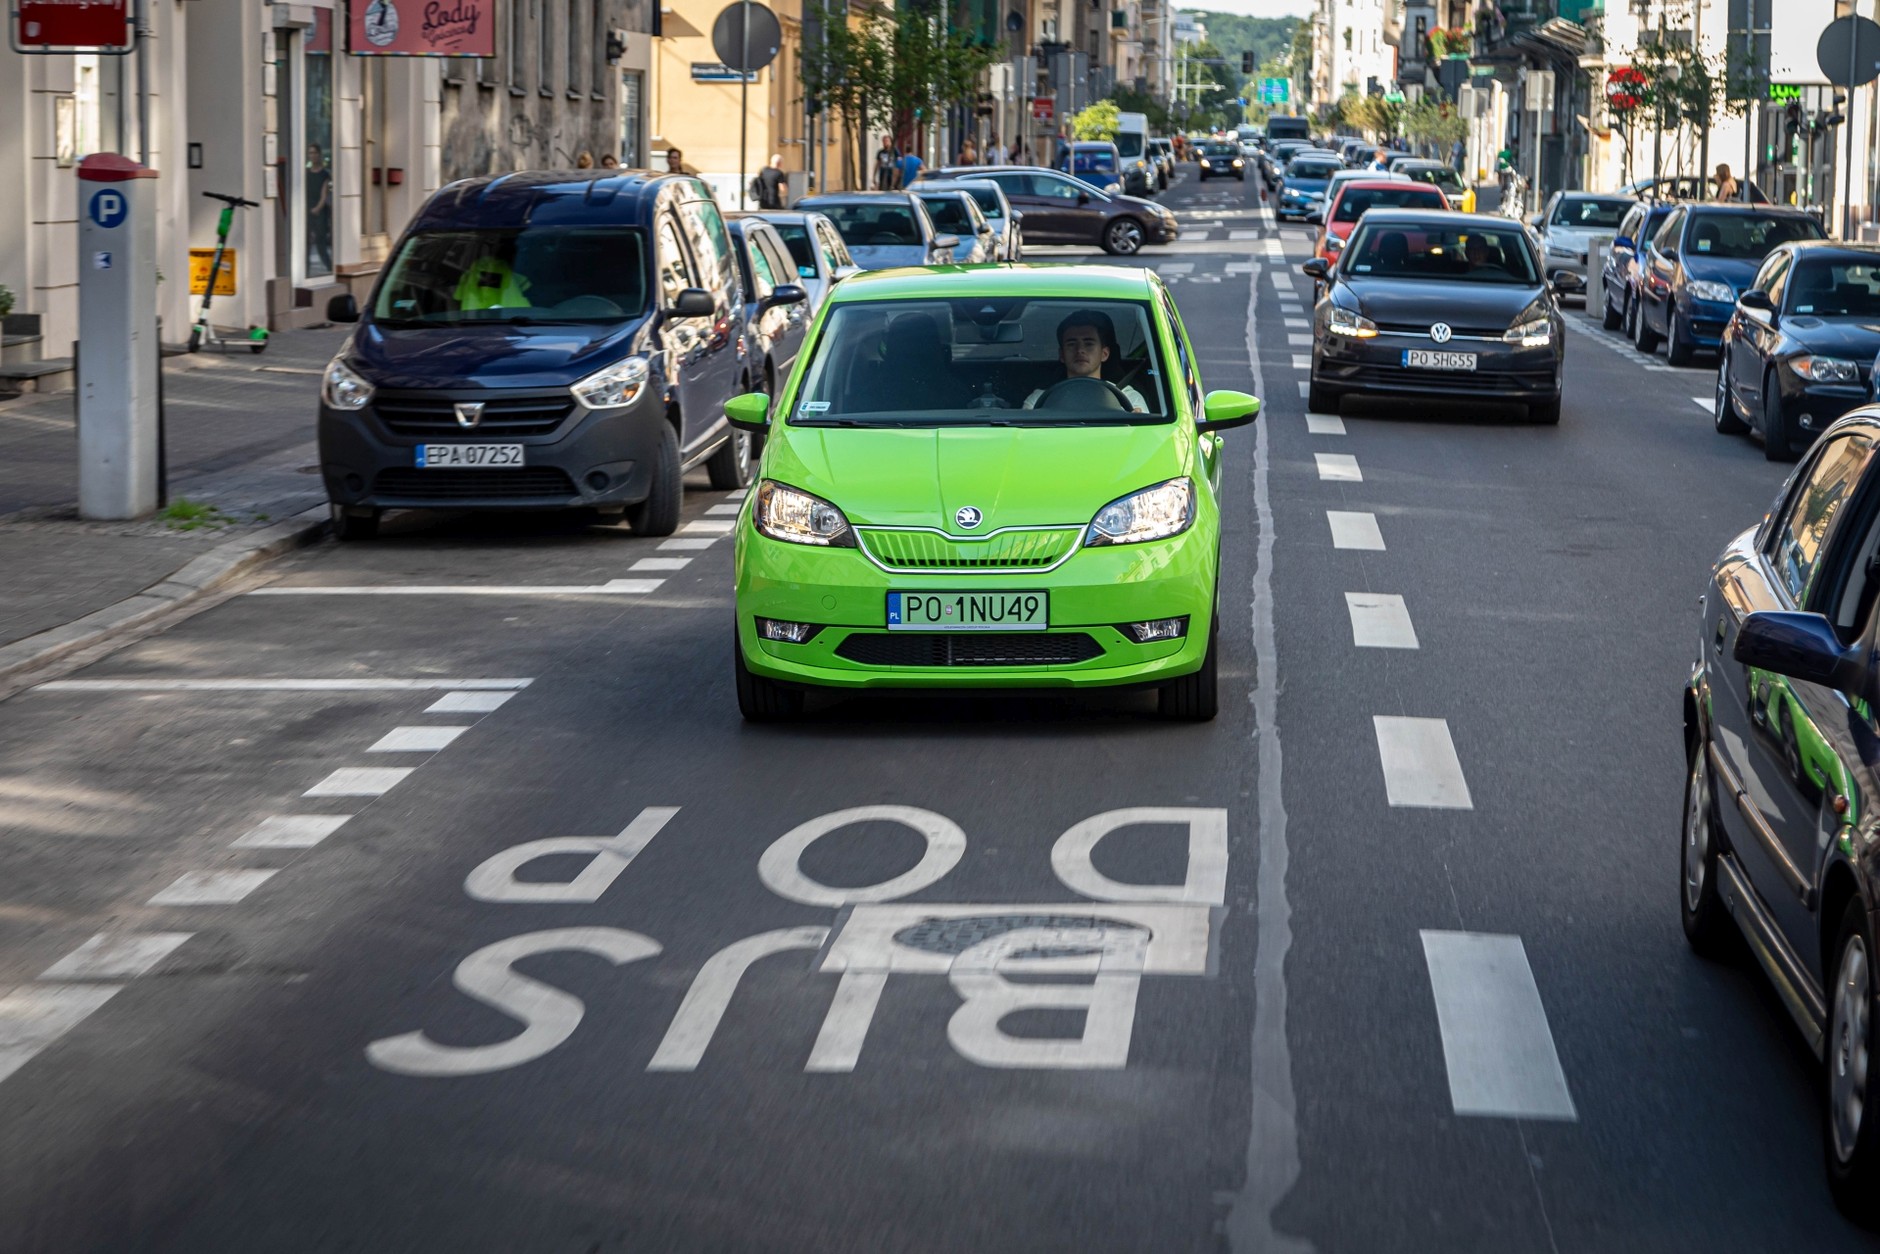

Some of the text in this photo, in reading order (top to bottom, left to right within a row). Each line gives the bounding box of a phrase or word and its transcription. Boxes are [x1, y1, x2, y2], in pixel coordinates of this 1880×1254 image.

[422, 0, 481, 34] Lody
[100, 194, 120, 222] P
[1411, 351, 1474, 368] PO 5HG55
[427, 446, 521, 464] EPA 07252
[890, 612, 900, 620] PL
[907, 596, 1039, 622] PO 1NU49
[464, 804, 1229, 907] DOP
[364, 925, 1153, 1076] BUS
